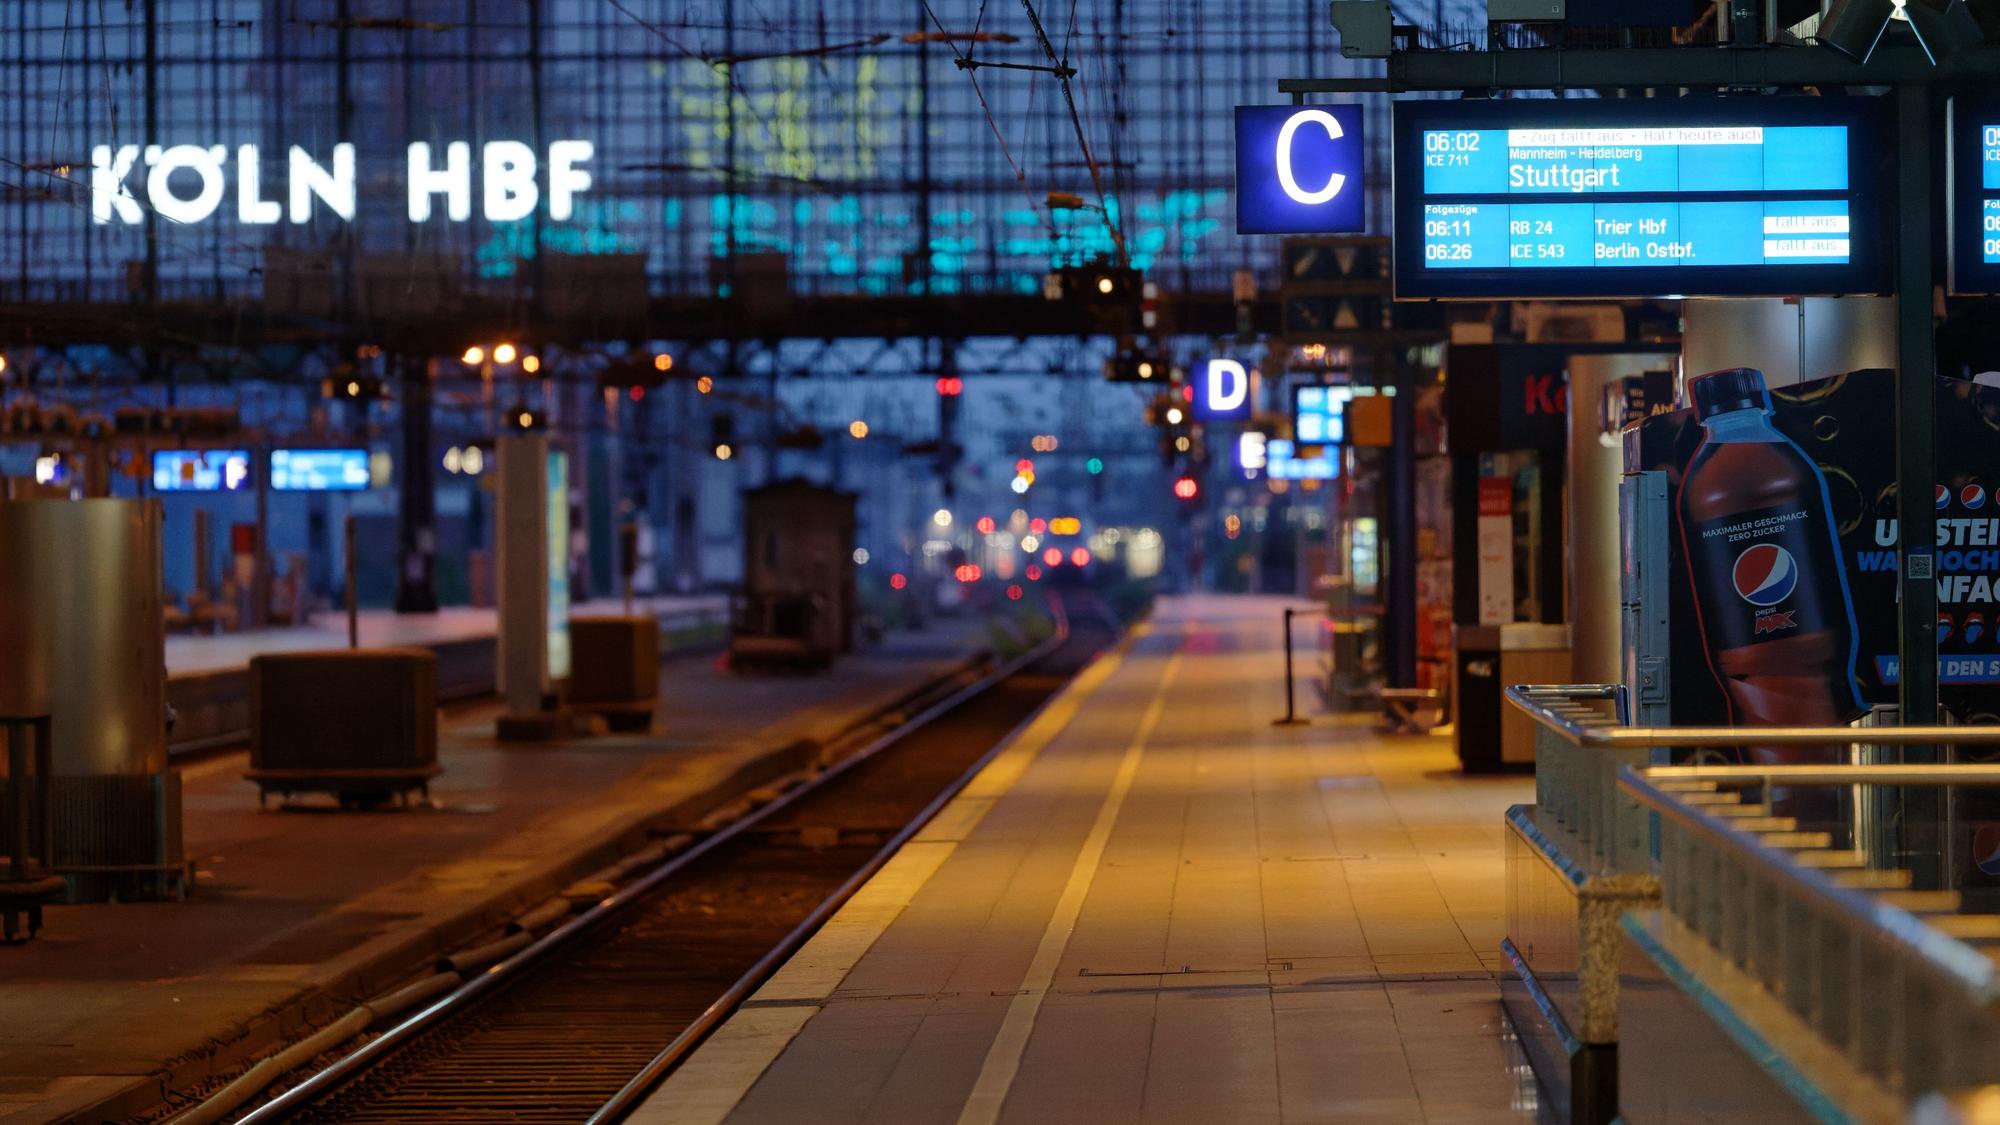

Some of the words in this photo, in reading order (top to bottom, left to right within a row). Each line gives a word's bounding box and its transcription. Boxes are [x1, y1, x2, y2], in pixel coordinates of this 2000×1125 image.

[1425, 133, 1480, 151] 06:02
[1530, 131, 1556, 145] Zug
[1598, 132, 1623, 142] aus
[1644, 129, 1673, 141] Halt
[1679, 129, 1722, 141] heute
[1727, 128, 1761, 141] auch
[1276, 109, 1346, 206] C
[1426, 154, 1444, 166] ICE
[1448, 154, 1469, 166] 711
[1509, 147, 1567, 160] Mannheim
[1578, 146, 1642, 161] Heidelberg
[91, 143, 356, 224] KÖLN
[407, 140, 595, 222] HBF
[1509, 163, 1620, 193] Stuttgart
[1425, 204, 1478, 216] Folgezüge
[1425, 220, 1470, 237] 06:11
[1510, 221, 1530, 235] RB
[1535, 221, 1553, 235] 24
[1594, 219, 1632, 235] Trier
[1638, 218, 1668, 235] Hbf
[1808, 217, 1837, 227] aus
[1425, 244, 1472, 260] 06:26
[1510, 243, 1533, 258] ICE
[1537, 243, 1565, 258] 543
[1594, 242, 1640, 259] Berlin
[1646, 242, 1696, 258] Ostbf.
[1808, 240, 1837, 251] aus
[1208, 358, 1248, 411] D
[1702, 521, 1753, 539] MAXIMALER
[1754, 510, 1809, 528] GESCHMACK
[1728, 532, 1752, 543] ZERO
[1753, 524, 1786, 538] ZUCKER
[1754, 605, 1777, 617] pepsi
[1754, 609, 1798, 635] MAX
[1946, 661, 1984, 676] DEN
